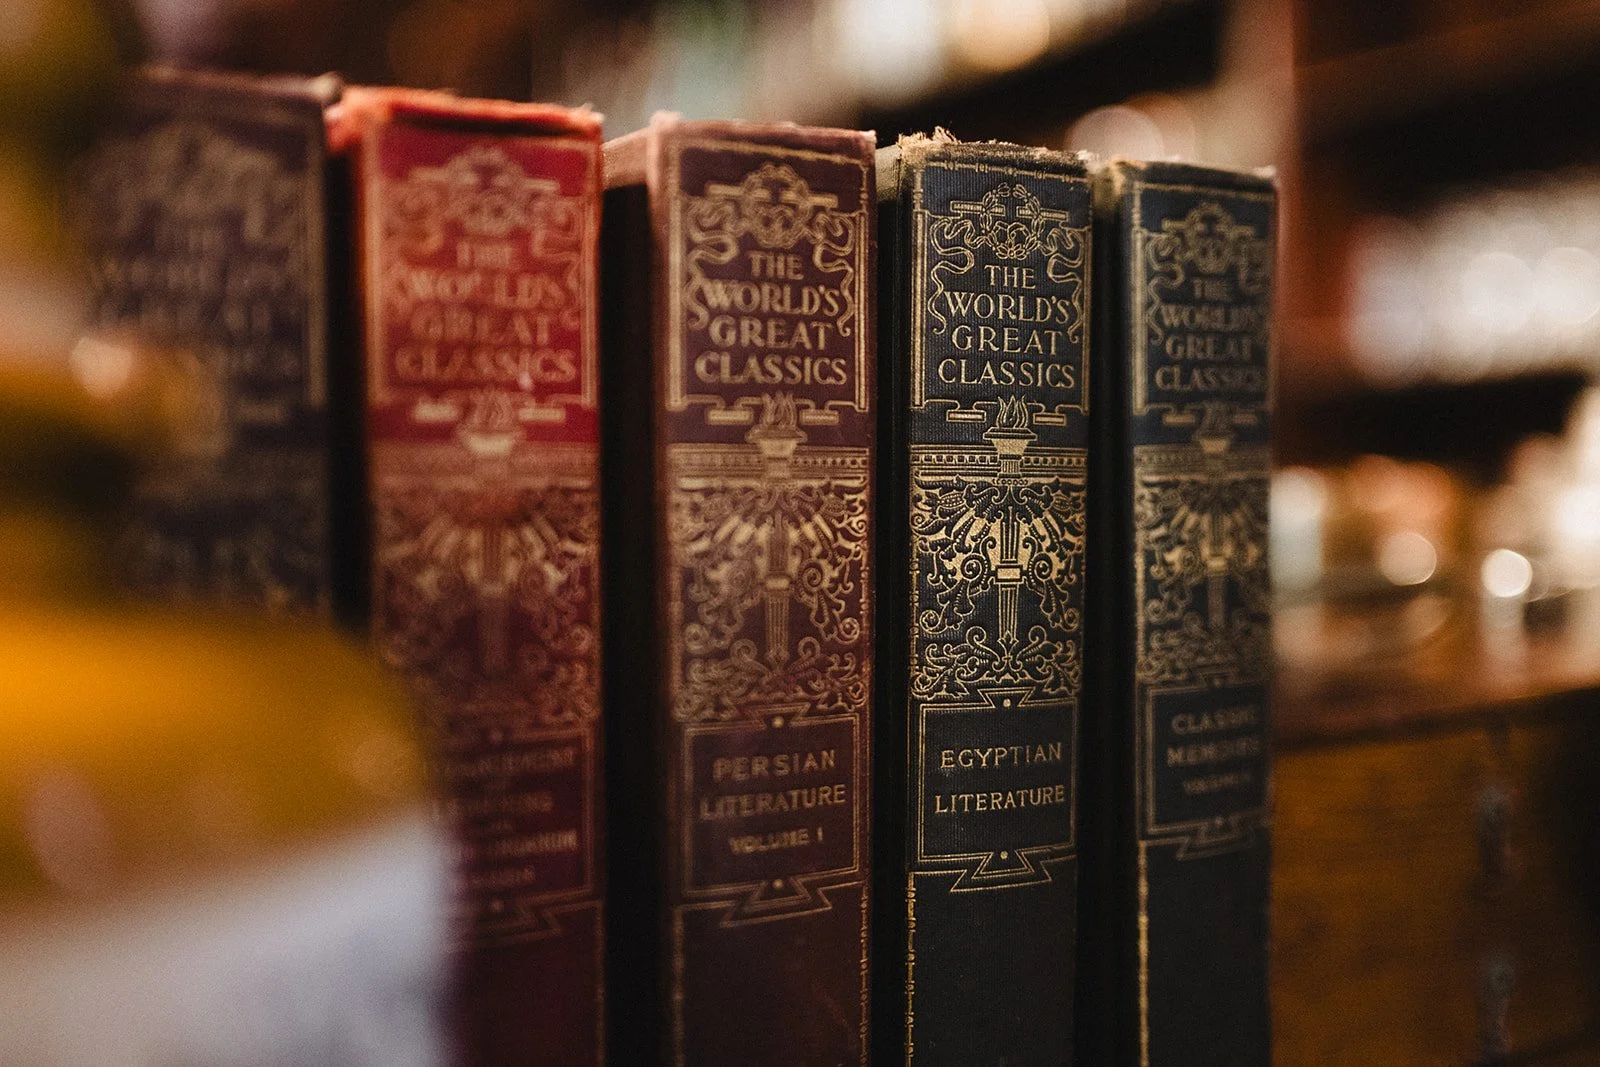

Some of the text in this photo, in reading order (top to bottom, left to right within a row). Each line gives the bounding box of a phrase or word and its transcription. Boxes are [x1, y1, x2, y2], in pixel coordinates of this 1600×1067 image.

[748, 251, 804, 280] THE
[984, 264, 1036, 289] THE
[700, 278, 840, 317] WORLD'S
[944, 291, 1070, 324] WORLD'S
[708, 315, 833, 350] GREAT
[951, 324, 1063, 356] GREAT
[694, 351, 848, 385] CLASSICS
[938, 358, 1076, 389] CLASSICS
[711, 750, 836, 782] PERSIAN
[940, 742, 1063, 769] EGYPTIAN
[701, 783, 848, 820] LITERATURE
[934, 784, 1066, 814] LITERATURE
[728, 827, 810, 855] VOLUME
